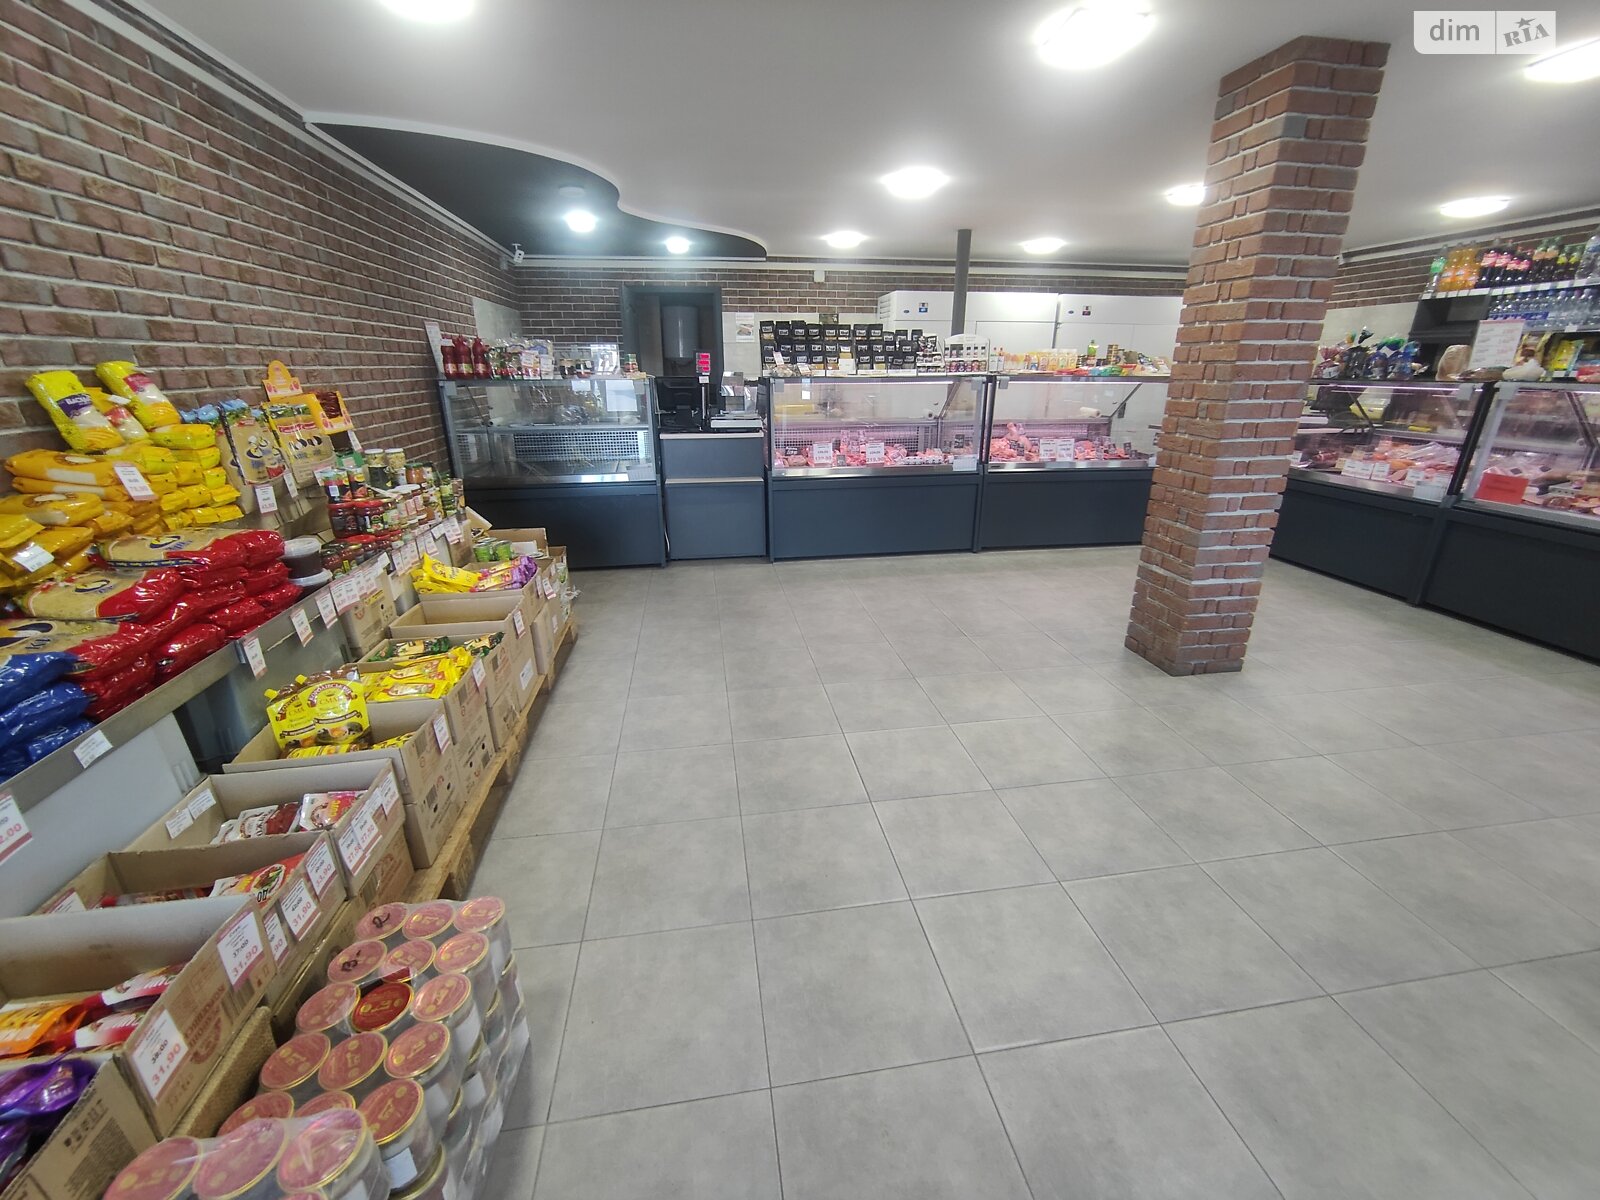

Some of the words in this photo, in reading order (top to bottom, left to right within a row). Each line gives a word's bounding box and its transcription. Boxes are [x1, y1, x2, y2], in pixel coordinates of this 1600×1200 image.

[292, 901, 312, 927] 31,90
[232, 945, 259, 978] 31,90
[151, 1042, 181, 1086] 31,90
